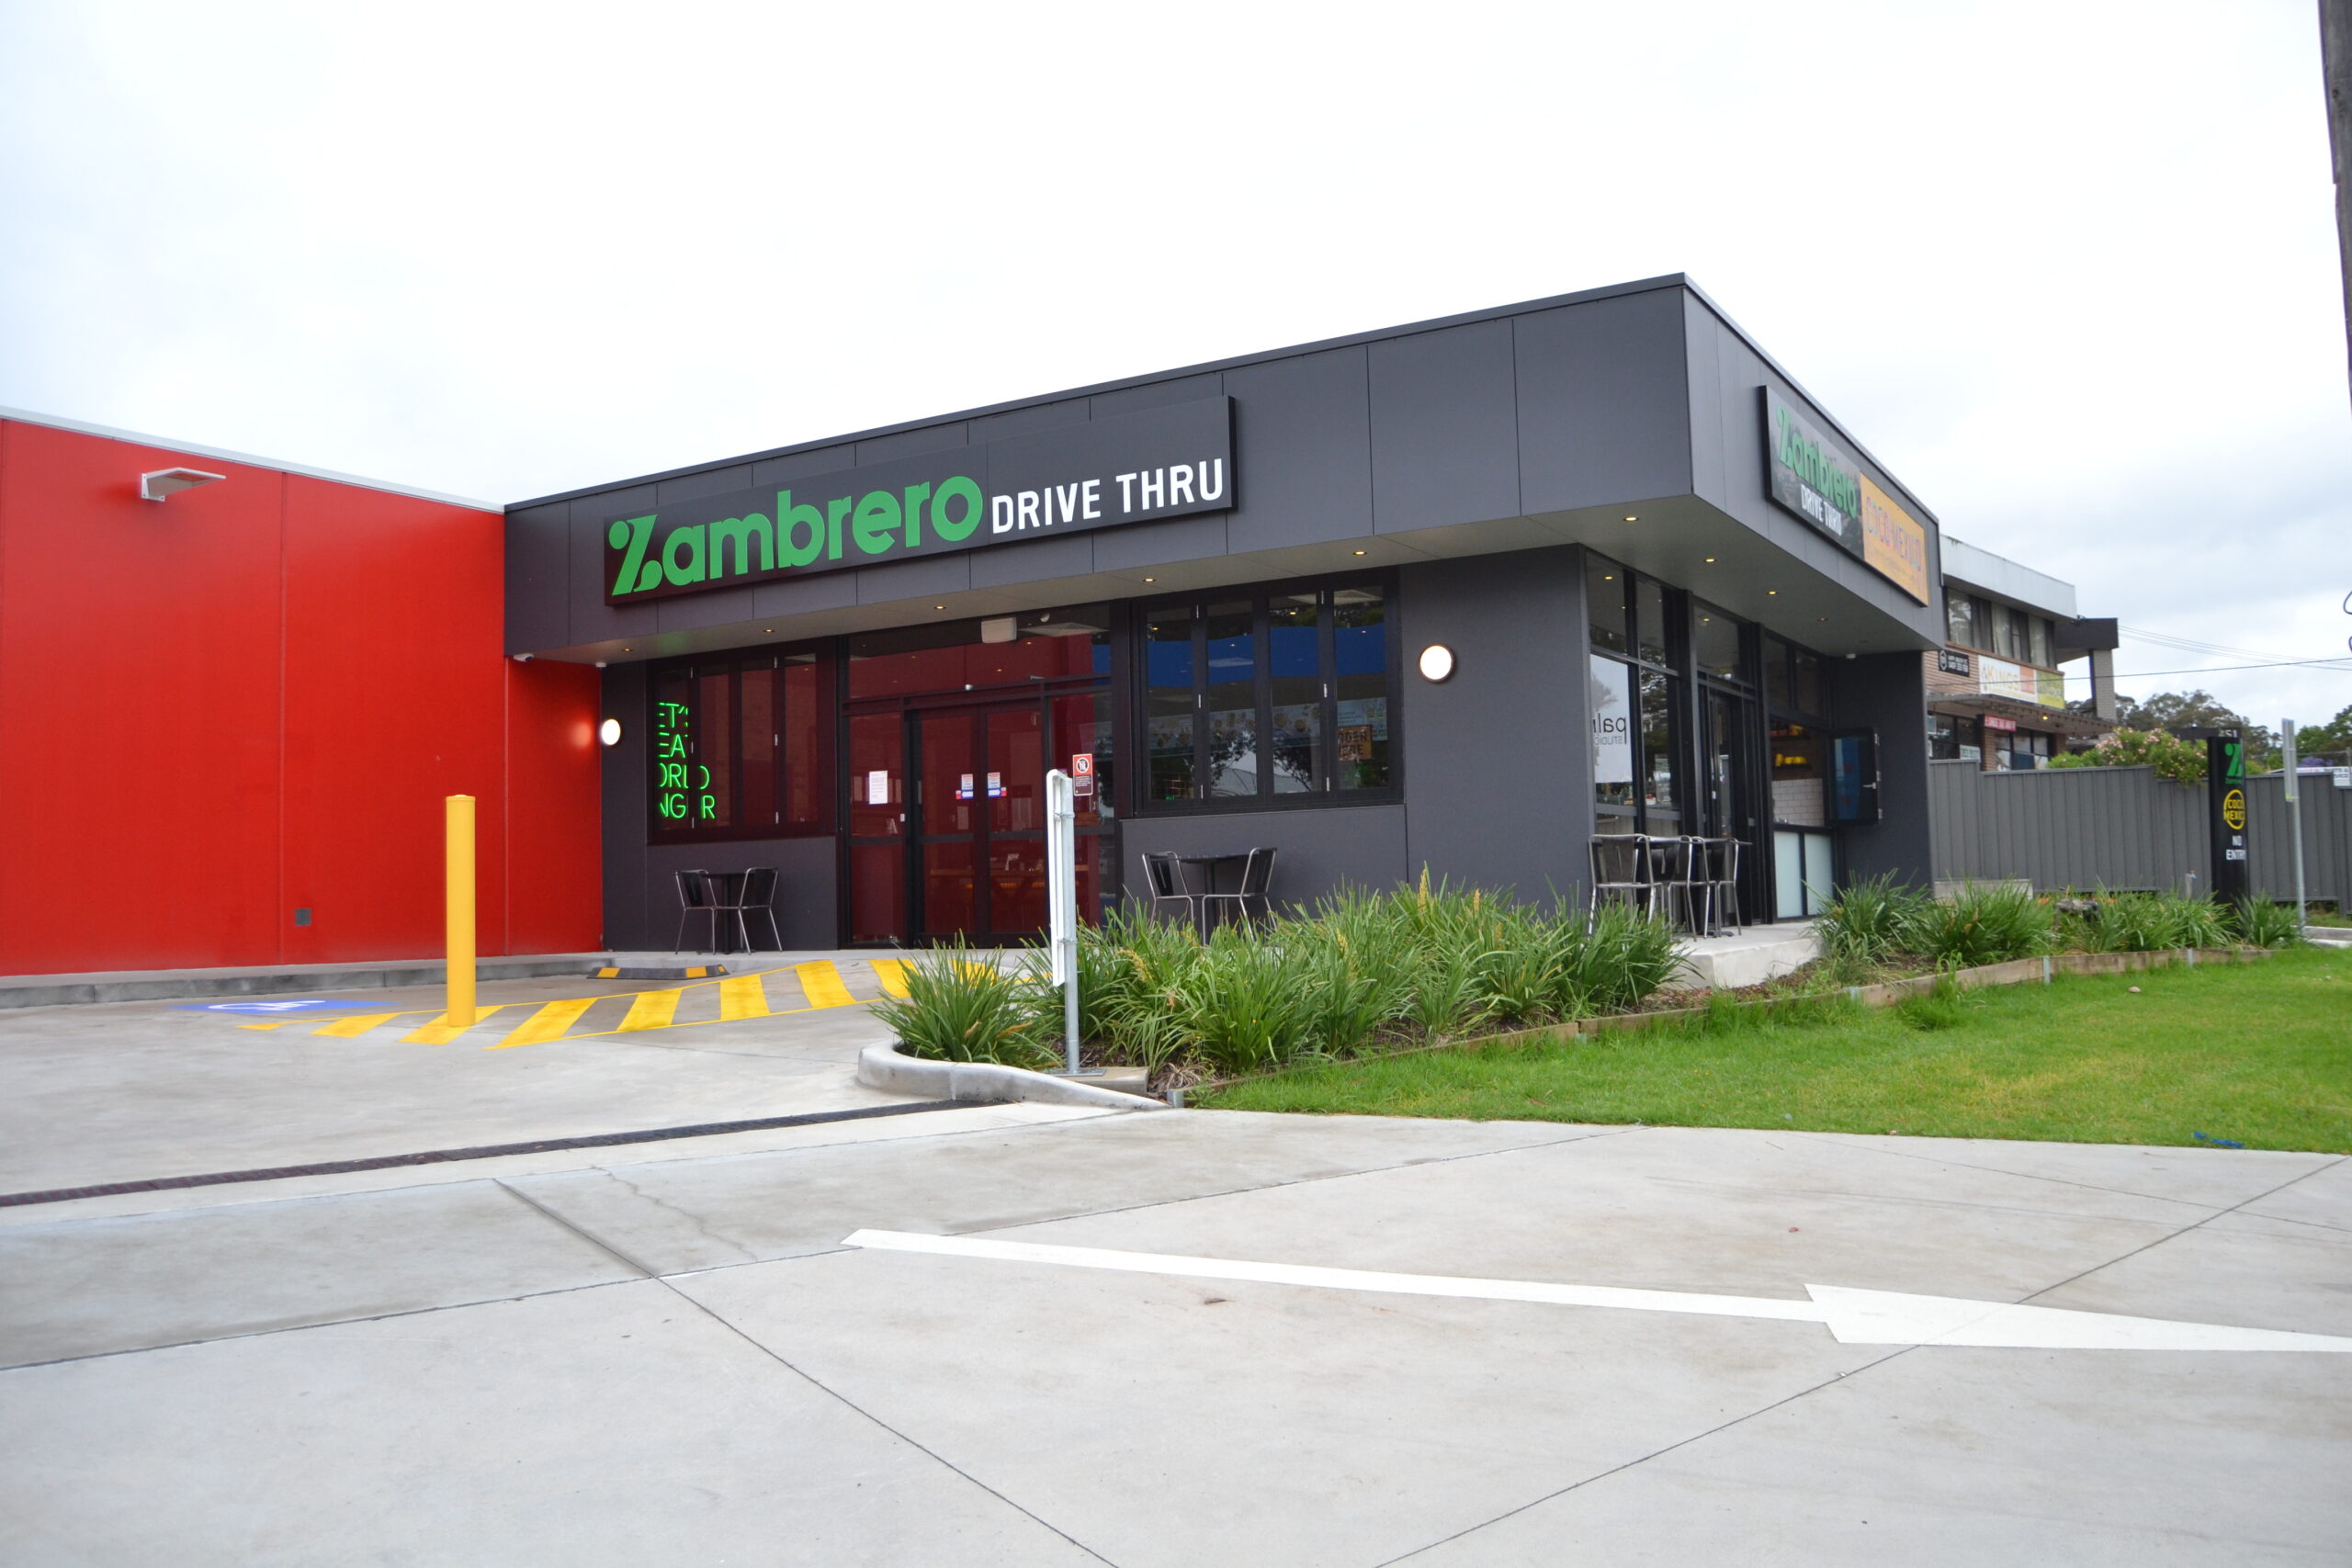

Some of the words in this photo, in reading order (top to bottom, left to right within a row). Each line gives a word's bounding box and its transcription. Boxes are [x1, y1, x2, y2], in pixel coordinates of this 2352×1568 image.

[1776, 403, 1858, 520] Zambrero
[607, 475, 984, 596] Zambrero
[991, 479, 1102, 535] DRIVE
[1115, 457, 1225, 513] THRU
[1801, 483, 1824, 523] DRIVE
[2232, 835, 2243, 847] NO
